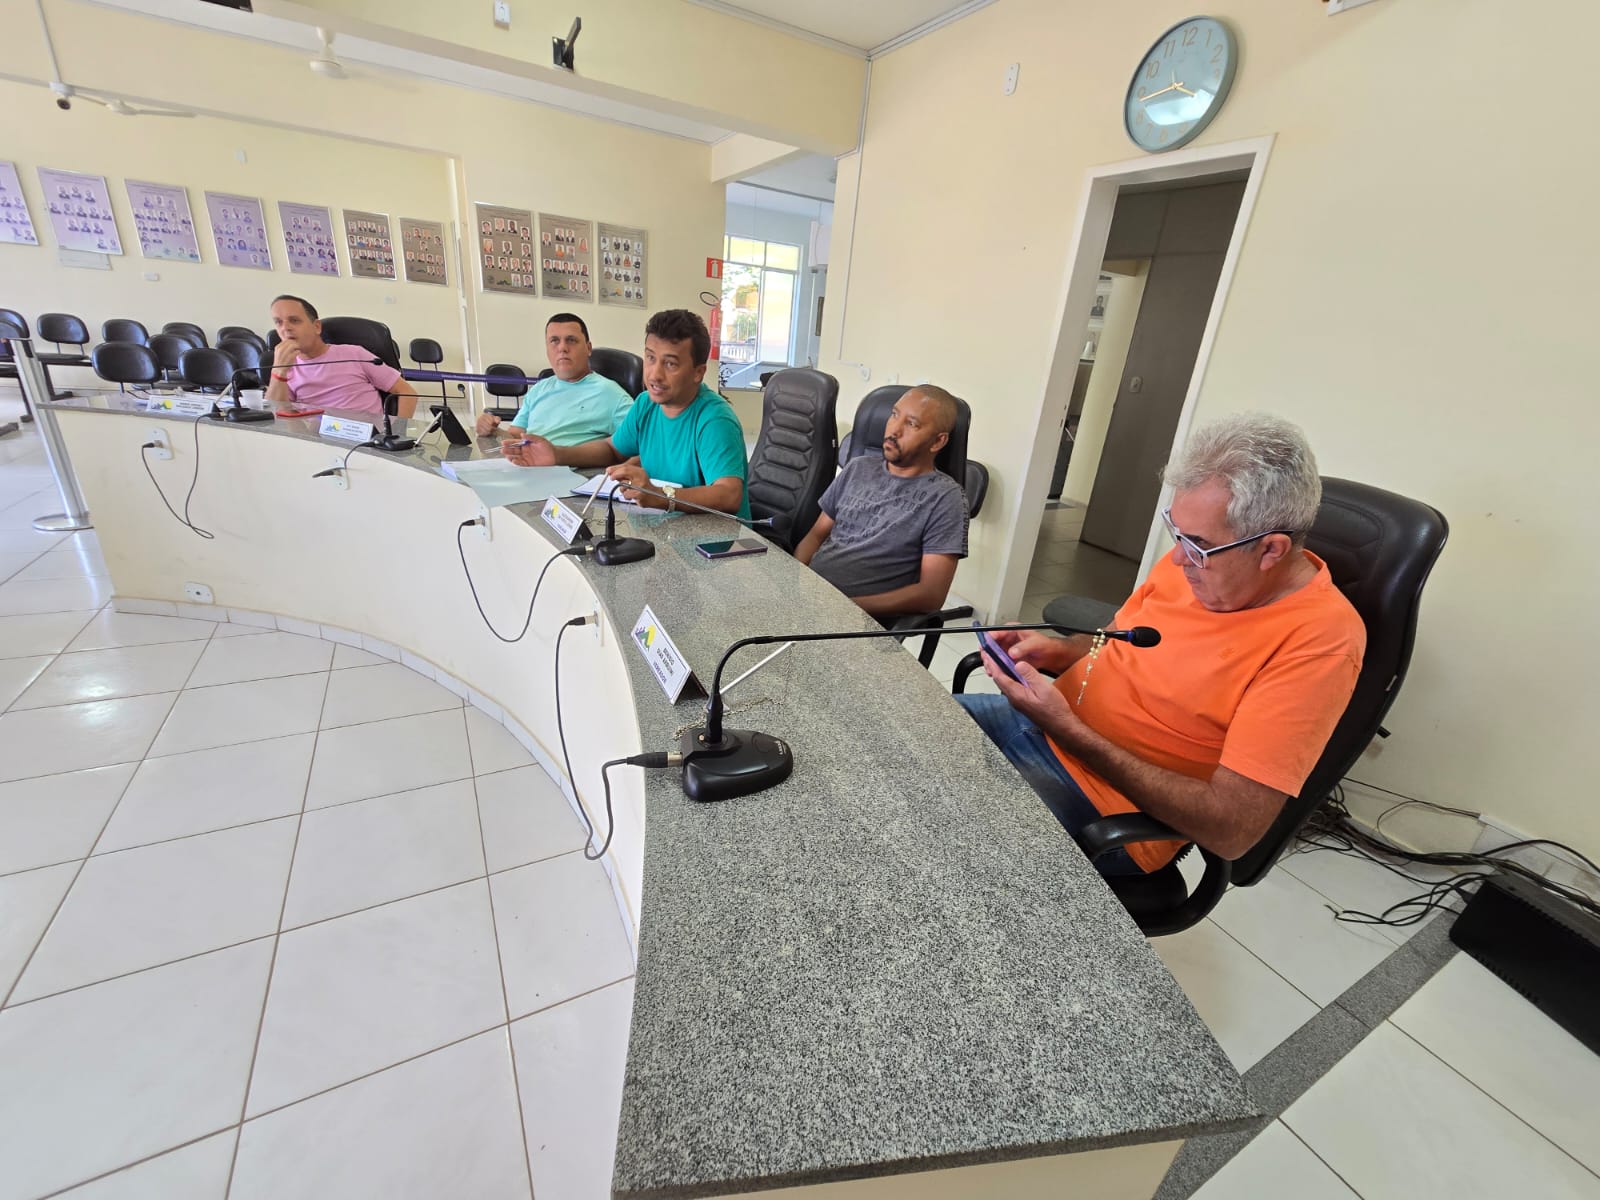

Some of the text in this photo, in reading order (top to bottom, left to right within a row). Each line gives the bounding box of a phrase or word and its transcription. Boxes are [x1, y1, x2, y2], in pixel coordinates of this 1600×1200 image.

[1181, 26, 1198, 47] 12
[1205, 28, 1213, 48] 1
[1163, 39, 1176, 58] 11
[1210, 44, 1223, 64] 2
[1145, 60, 1160, 80] 10
